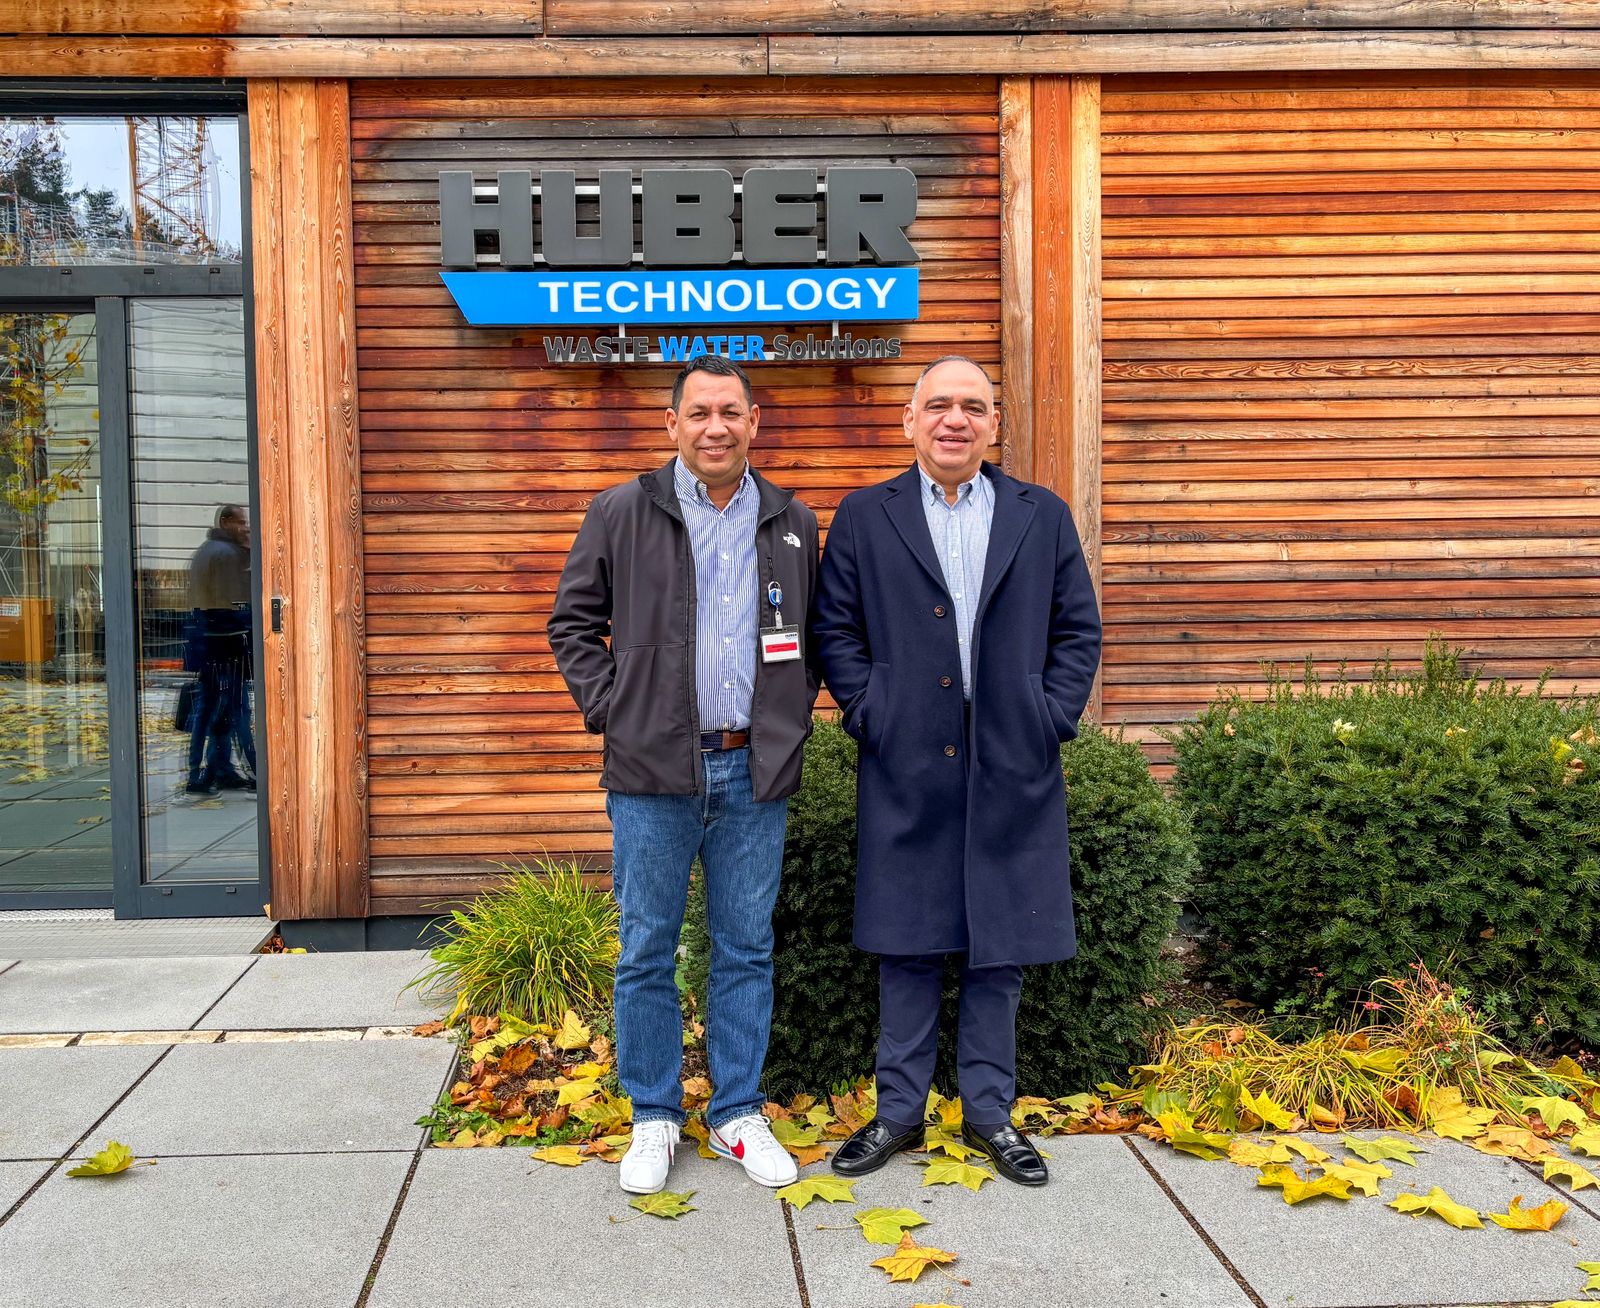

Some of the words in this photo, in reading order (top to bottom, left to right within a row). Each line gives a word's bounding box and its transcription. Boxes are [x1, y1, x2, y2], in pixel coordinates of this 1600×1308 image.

[439, 167, 921, 270] HUBER
[538, 278, 897, 313] TECHNOLOGY
[543, 336, 649, 362] WASTE
[658, 335, 765, 362] WATER
[773, 333, 902, 360] Solutions
